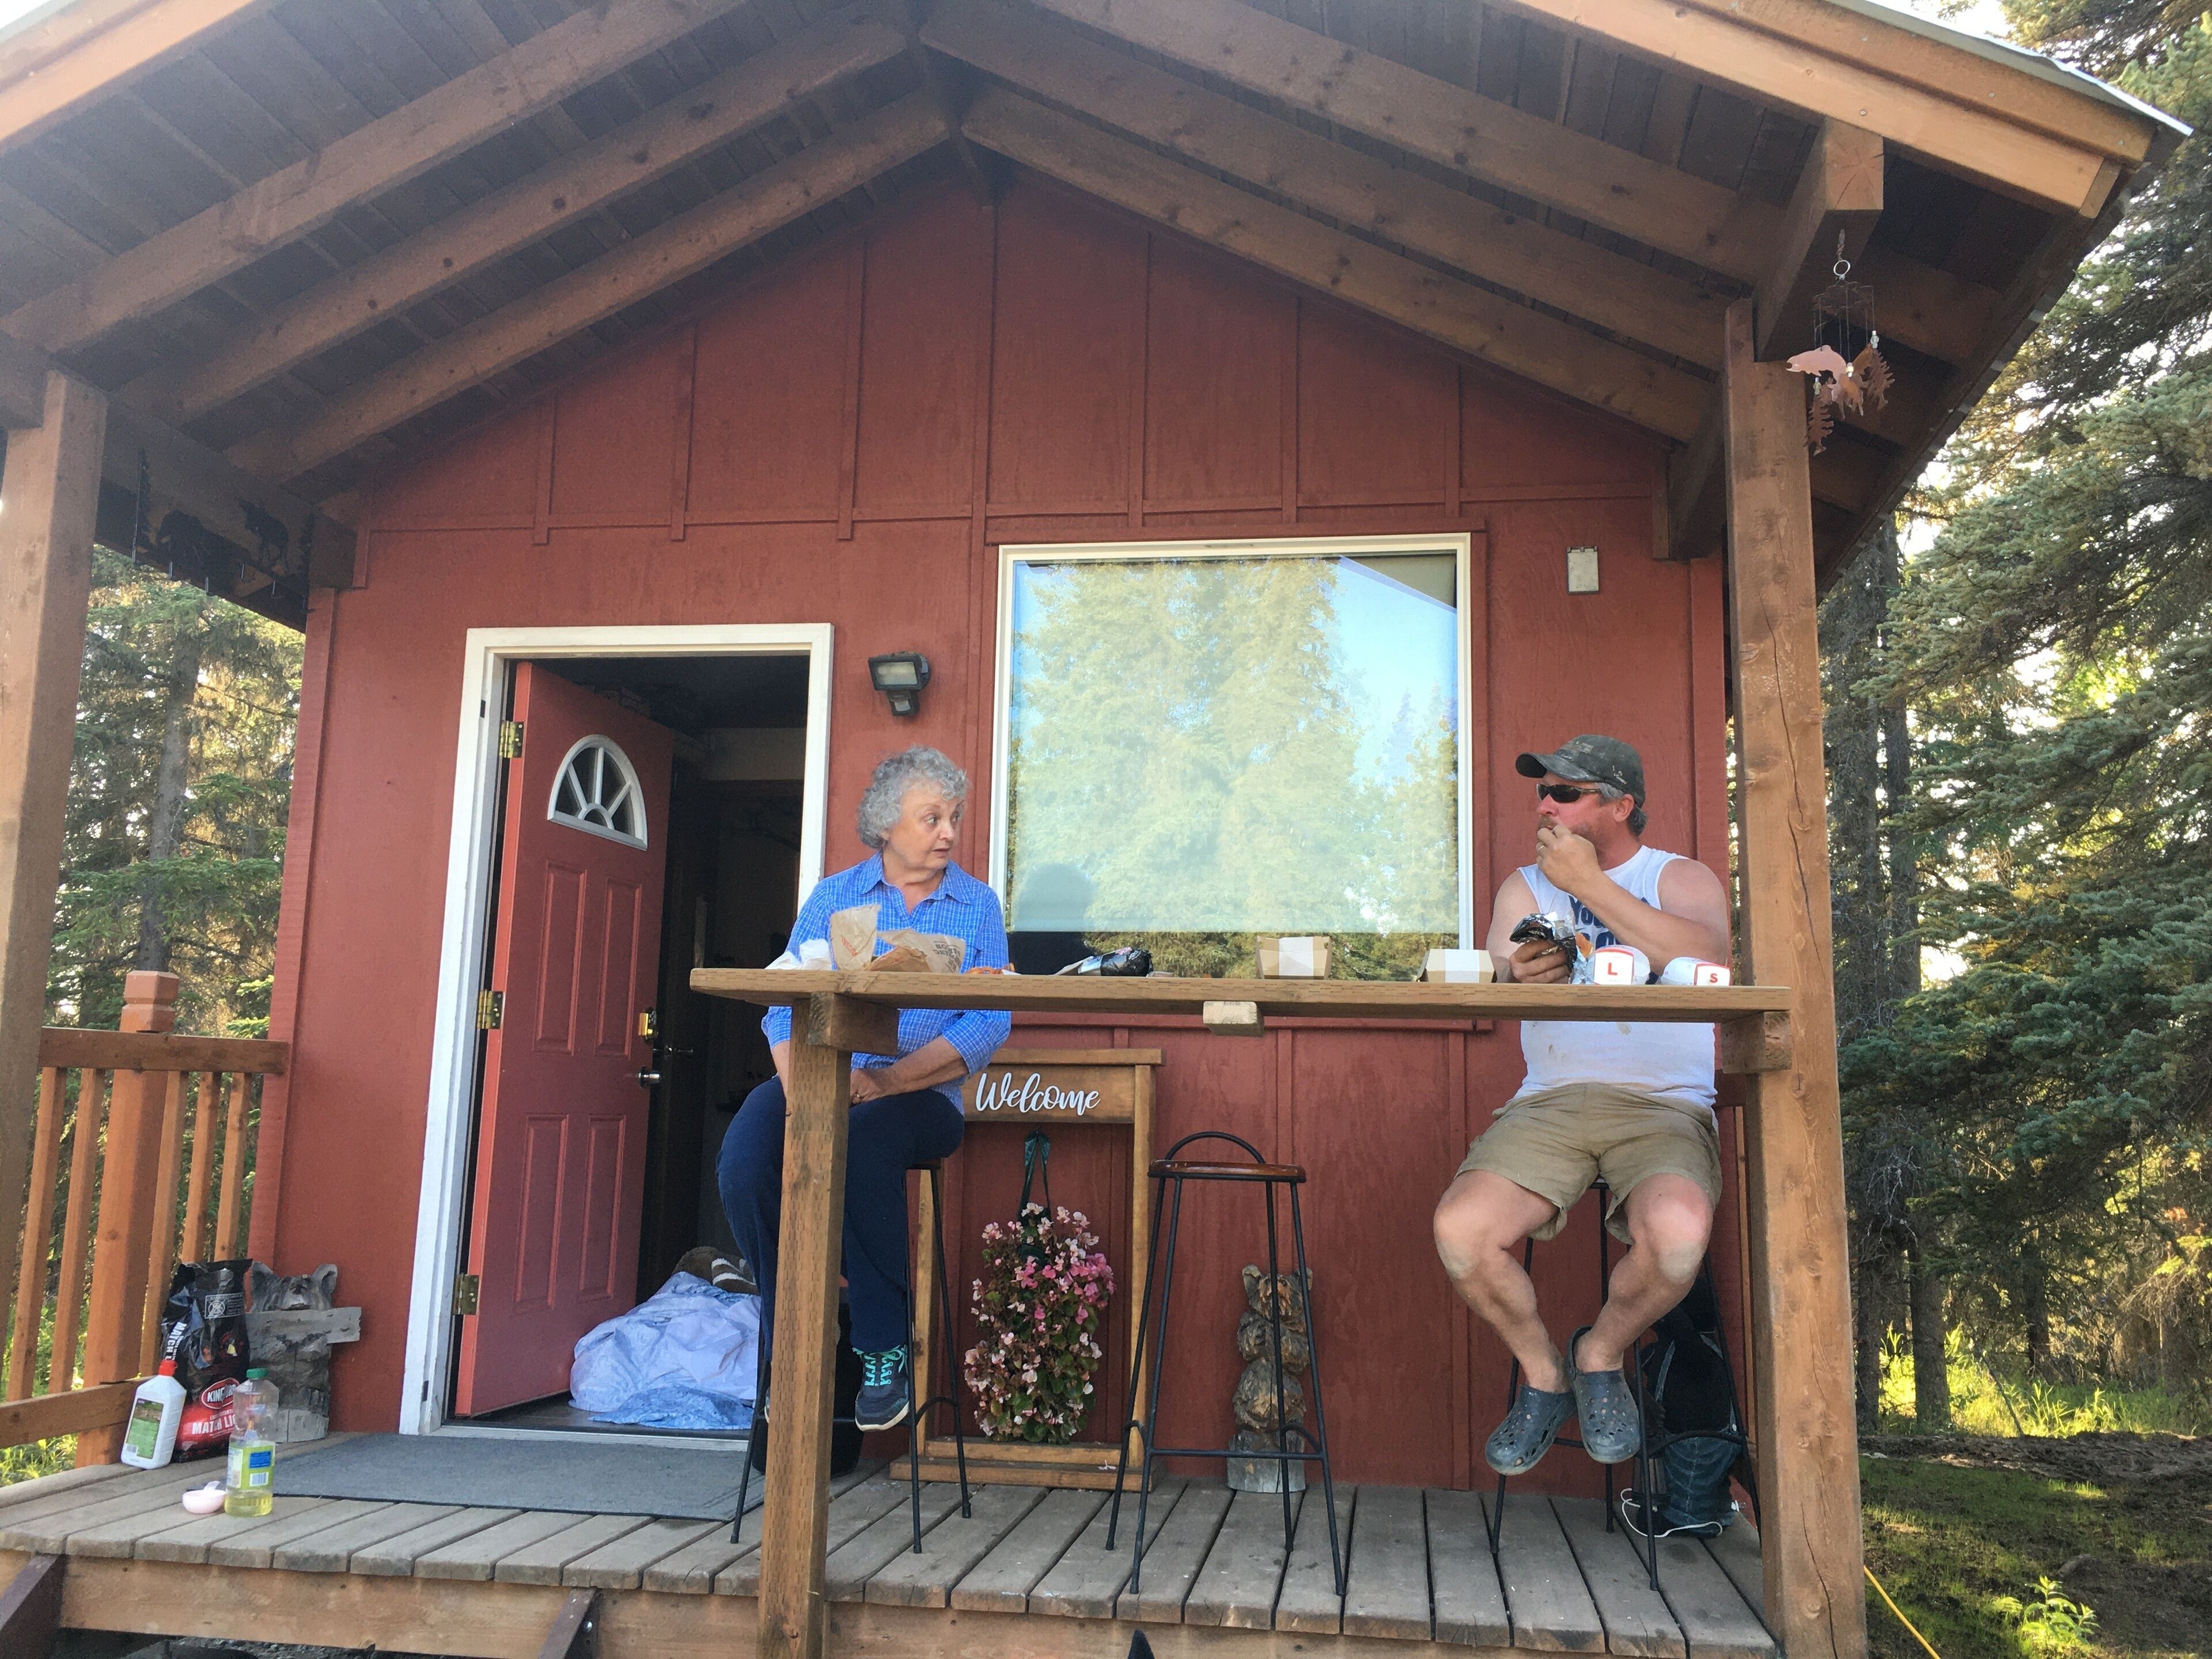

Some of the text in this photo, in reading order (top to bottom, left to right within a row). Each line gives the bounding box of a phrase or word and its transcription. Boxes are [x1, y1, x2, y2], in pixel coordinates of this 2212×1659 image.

[1608, 962, 1618, 976] L
[1710, 973, 1718, 983] S
[976, 1072, 1101, 1116] Welcome
[166, 1321, 187, 1353] MATCH
